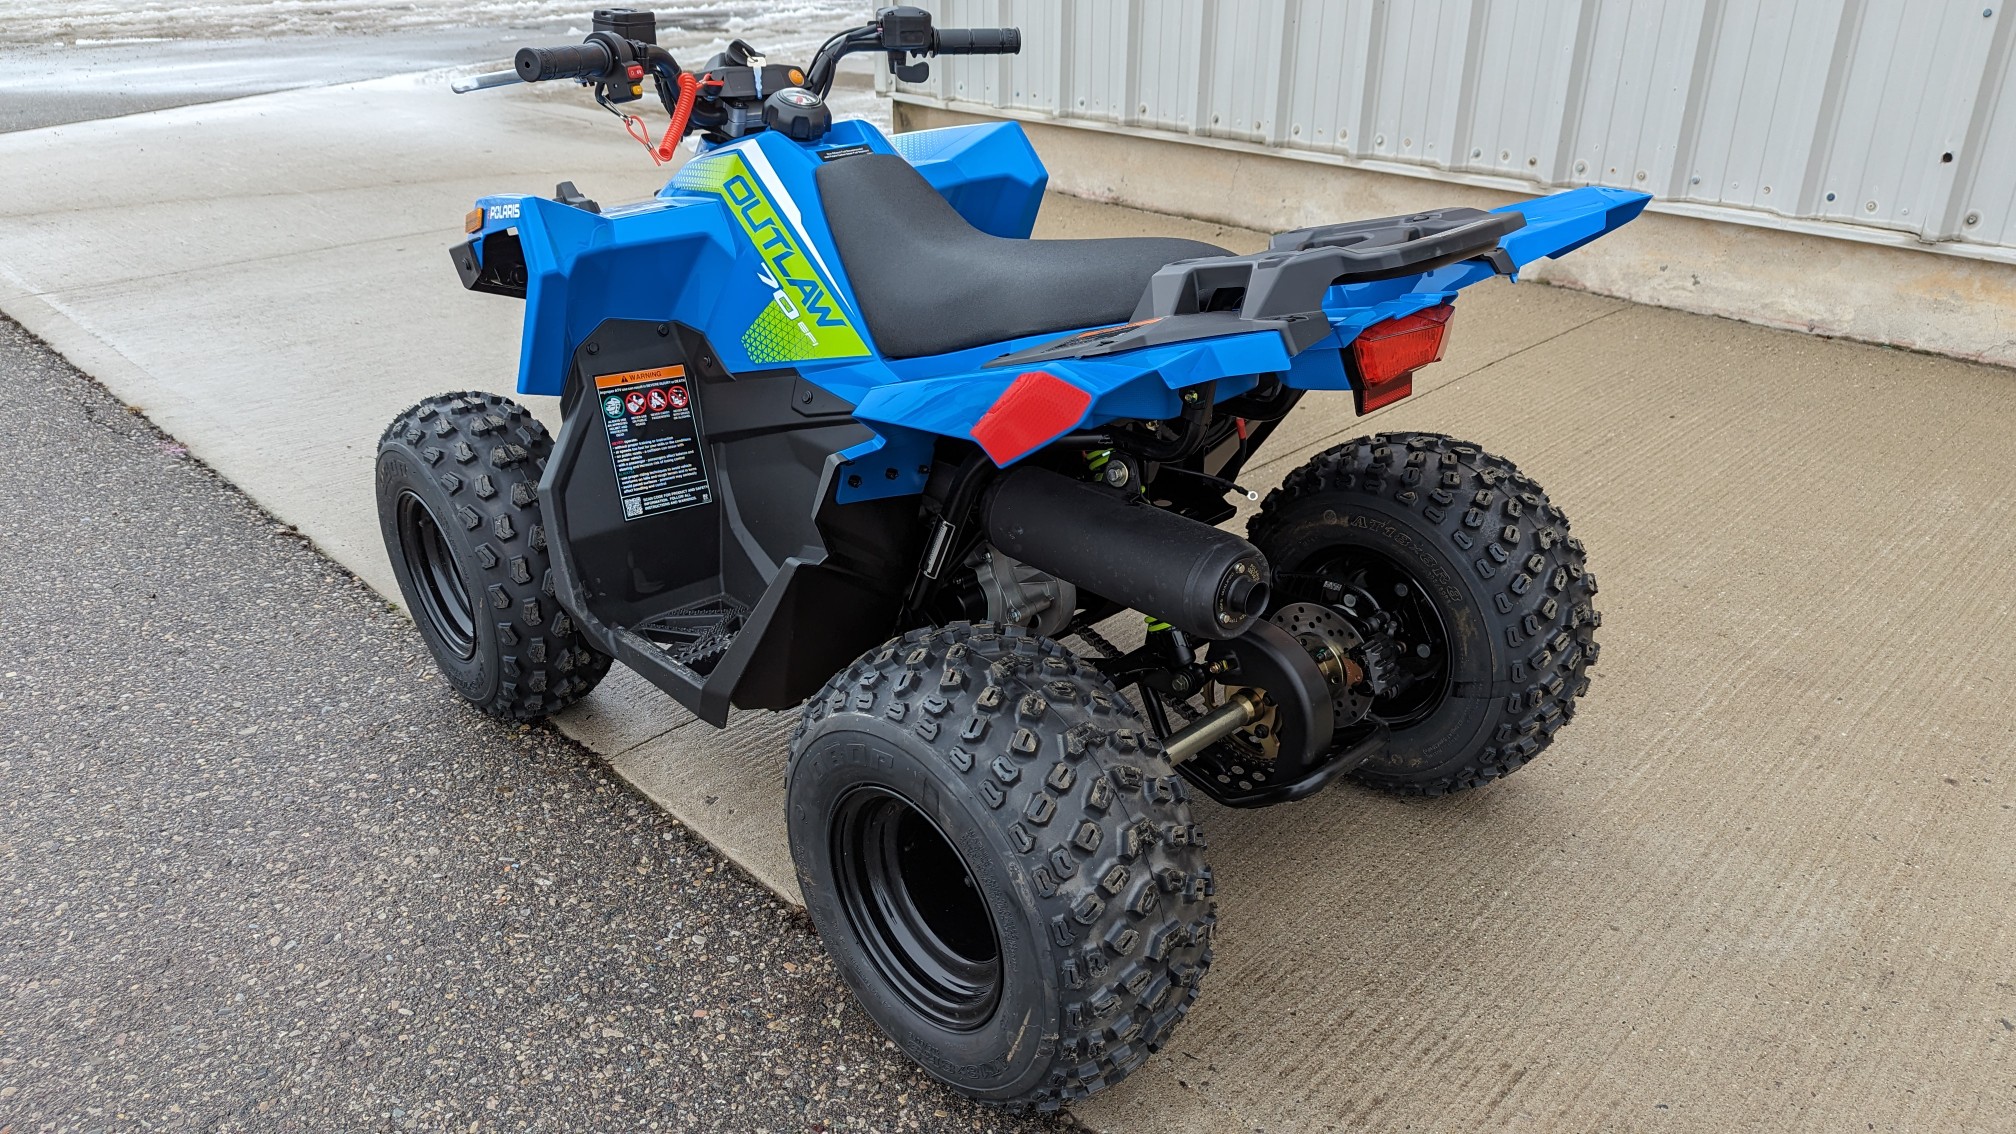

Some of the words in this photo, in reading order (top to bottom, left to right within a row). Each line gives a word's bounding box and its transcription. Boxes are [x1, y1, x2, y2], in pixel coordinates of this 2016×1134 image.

[490, 203, 520, 219] POLARIS
[723, 175, 848, 327] OUTLAW
[757, 262, 800, 320] 70
[629, 370, 662, 382] WARNING
